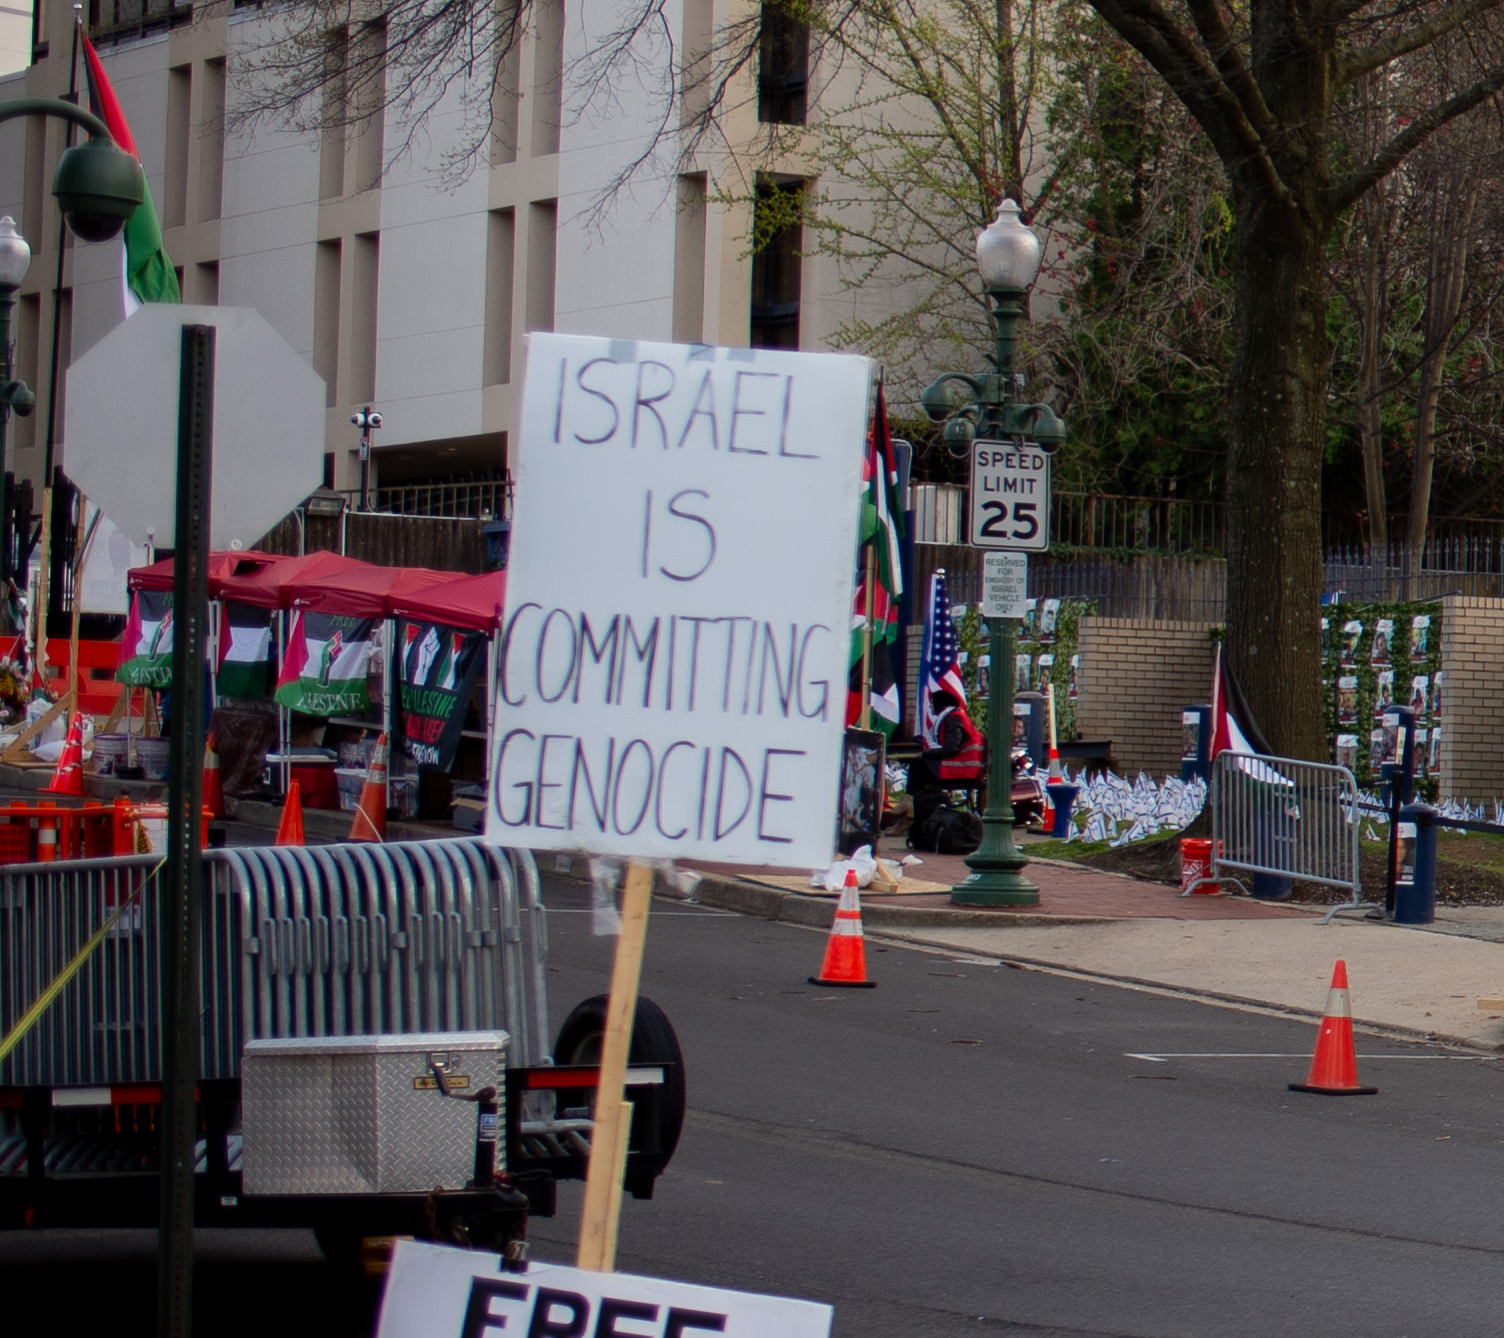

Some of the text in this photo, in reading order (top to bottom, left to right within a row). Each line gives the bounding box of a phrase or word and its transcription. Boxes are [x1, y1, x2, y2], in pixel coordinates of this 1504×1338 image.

[553, 356, 821, 459] ISRAEL
[978, 451, 1044, 470] SPEED
[984, 476, 1037, 494] LIMIT
[642, 488, 717, 582] IS
[980, 500, 1039, 540] 25
[499, 602, 833, 722] COMMITTING
[494, 728, 807, 844] GENOCIDE
